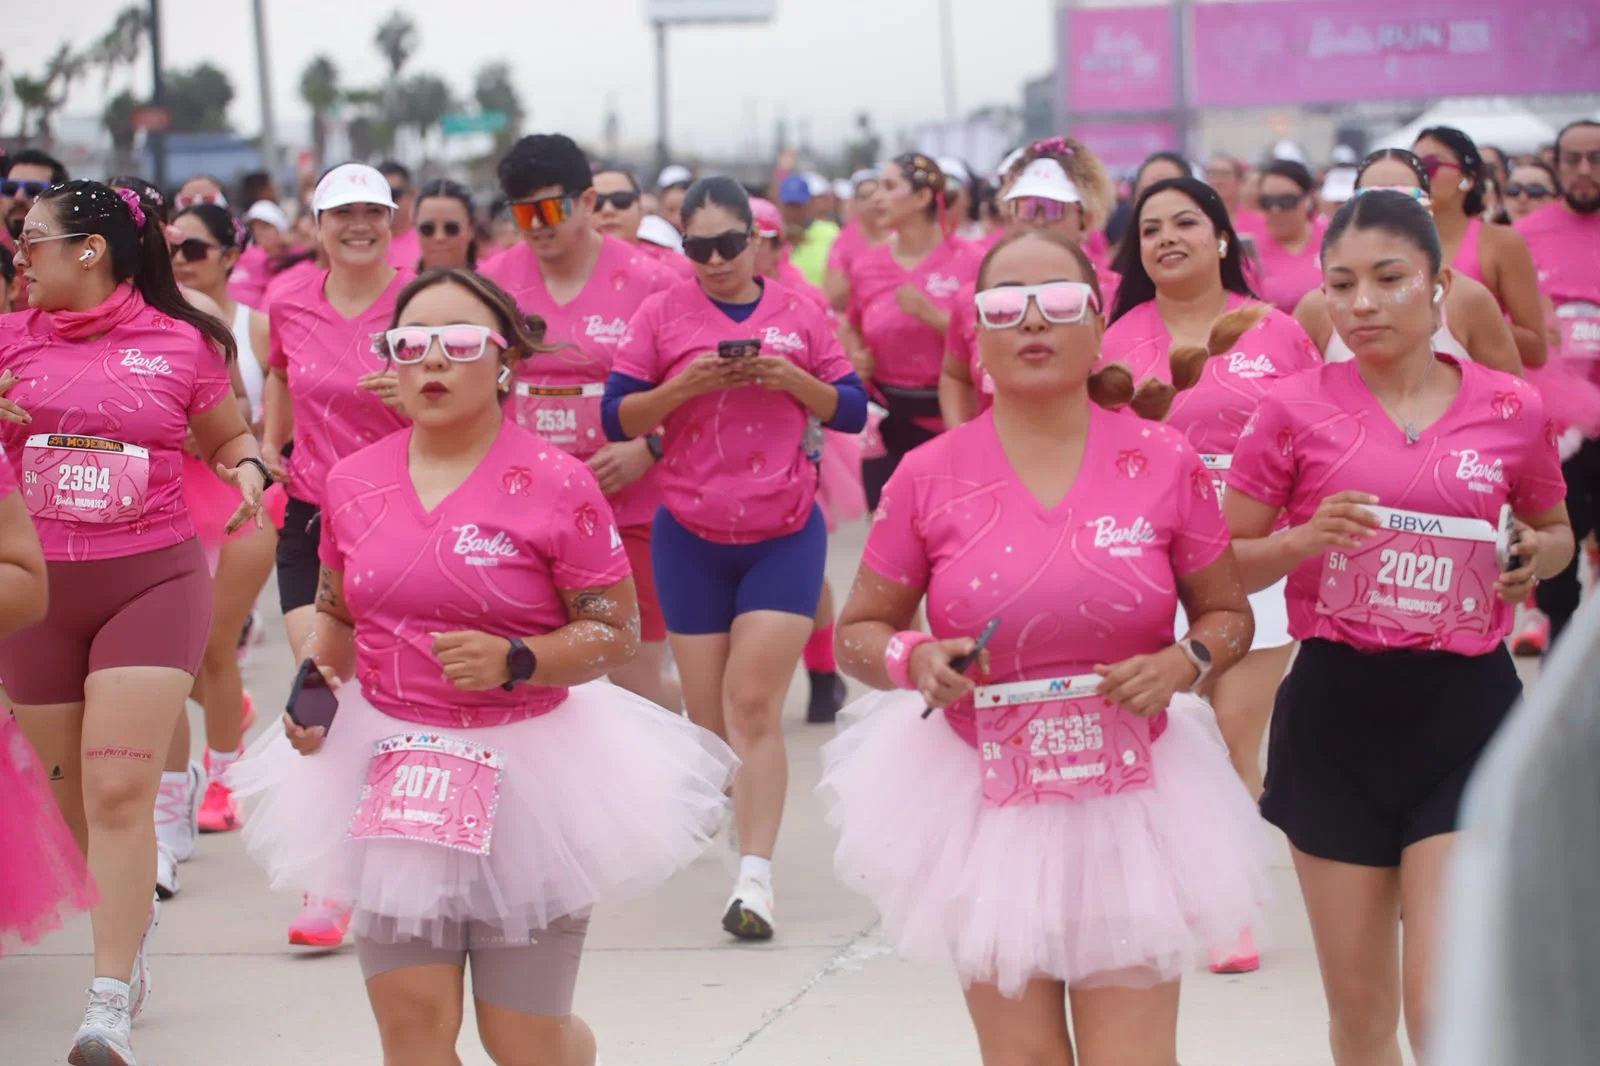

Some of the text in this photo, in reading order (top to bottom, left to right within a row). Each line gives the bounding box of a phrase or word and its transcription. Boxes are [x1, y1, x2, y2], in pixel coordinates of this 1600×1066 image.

[120, 348, 173, 375] Barbie
[1228, 352, 1276, 373] Barbie
[536, 409, 577, 431] 2534
[58, 464, 110, 493] 2394
[1455, 449, 1504, 483] Barbie
[1094, 516, 1156, 547] Barbie
[1389, 514, 1443, 533] BBVA
[453, 523, 520, 557] Barbie
[1377, 549, 1453, 592] 2020
[1028, 712, 1103, 756] 2535
[392, 765, 451, 800] 2071
